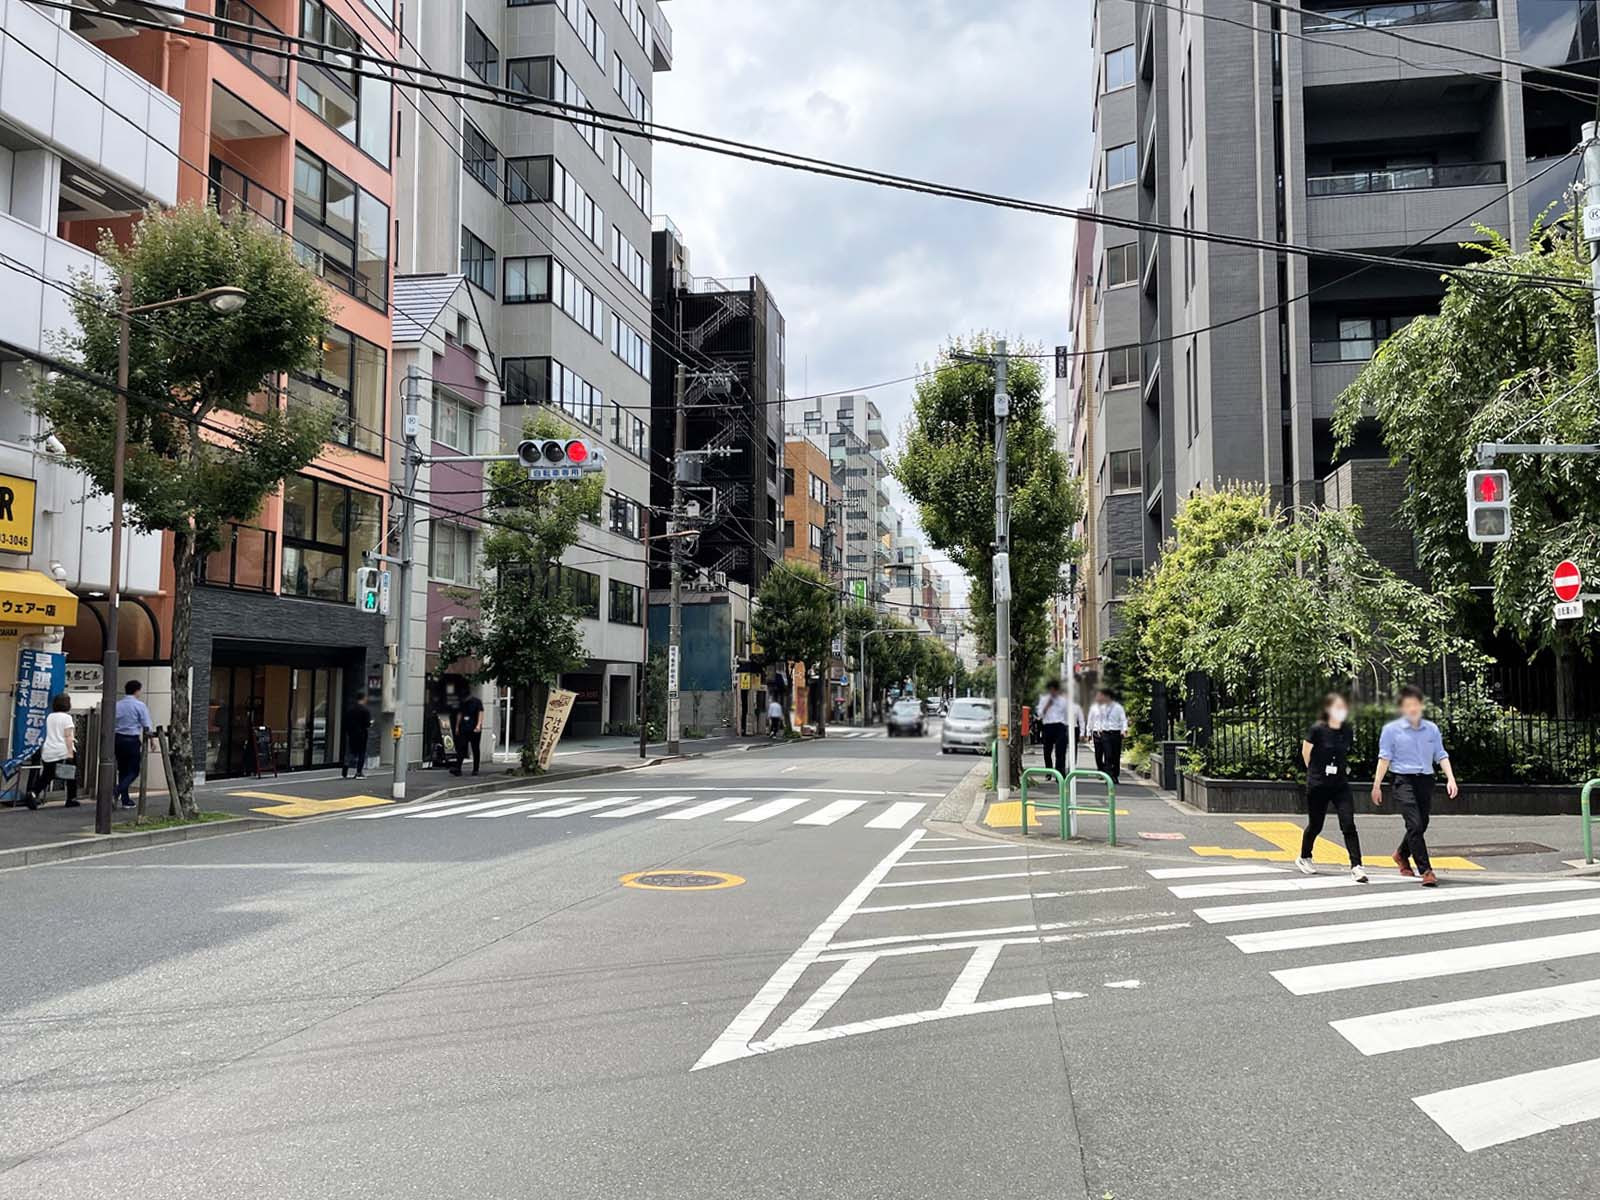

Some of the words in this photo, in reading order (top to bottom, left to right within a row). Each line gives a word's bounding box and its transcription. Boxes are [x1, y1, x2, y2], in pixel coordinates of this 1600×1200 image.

[0, 533, 28, 547] 3-3046
[2, 600, 56, 616] ウェアー店
